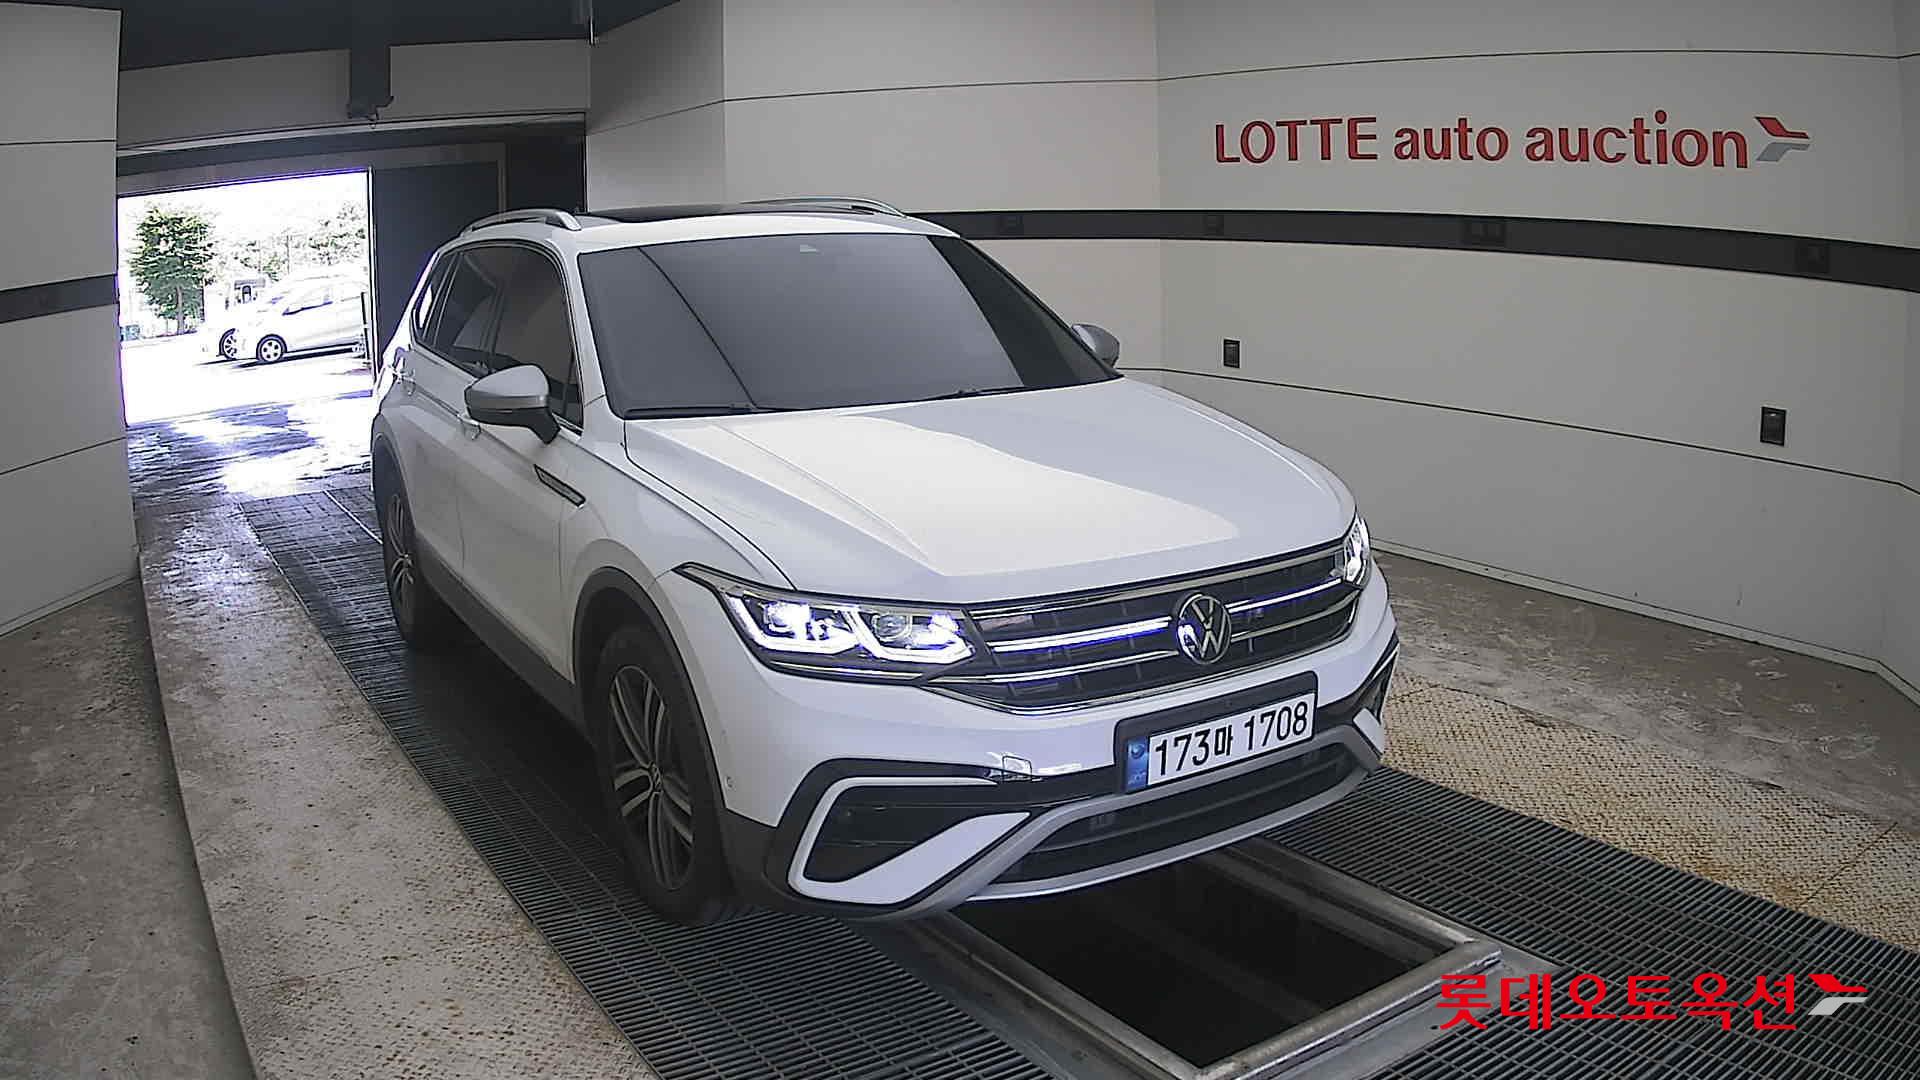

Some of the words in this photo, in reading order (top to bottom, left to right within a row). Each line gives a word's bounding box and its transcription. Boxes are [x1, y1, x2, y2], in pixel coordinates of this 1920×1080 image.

[1214, 117, 1378, 164] LOTTE
[1394, 117, 1509, 162] auto
[1524, 110, 1749, 169] auction
[1155, 725, 1234, 776] 173마
[1244, 701, 1308, 751] 1708
